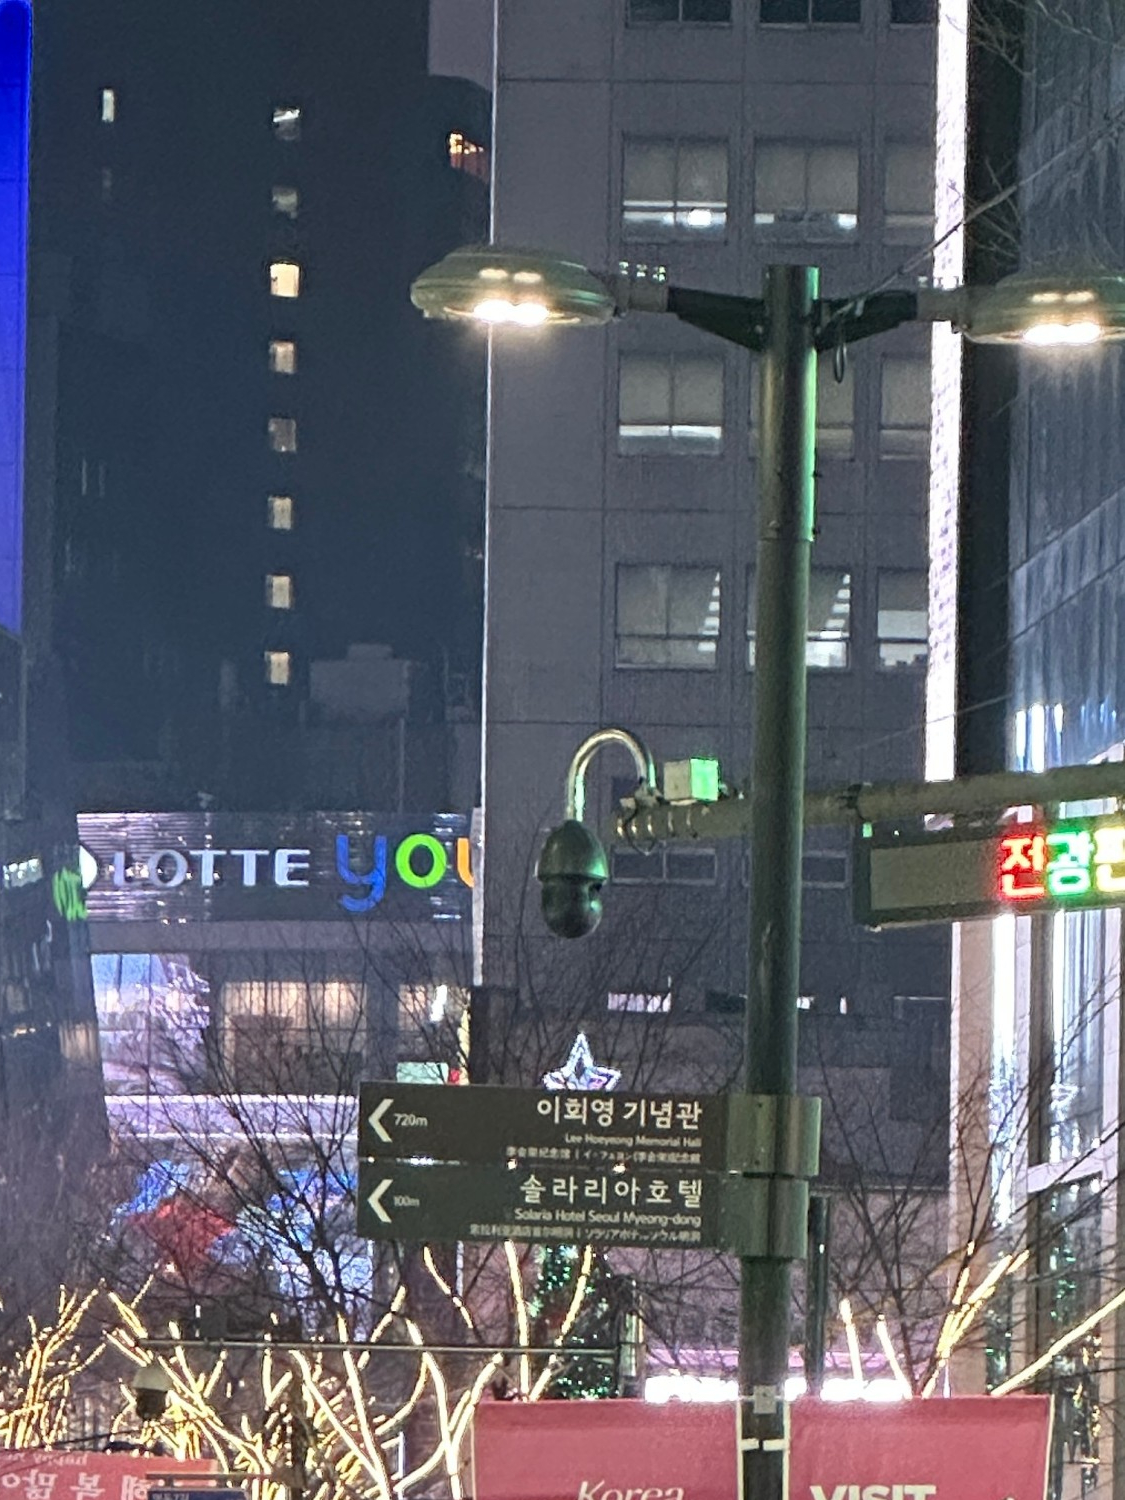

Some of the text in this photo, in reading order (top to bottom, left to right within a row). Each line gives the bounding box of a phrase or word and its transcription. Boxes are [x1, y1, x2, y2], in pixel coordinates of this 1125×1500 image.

[113, 848, 311, 887] LOTTE
[394, 1113, 428, 1126] 720m
[537, 1096, 703, 1130] 이회영 기념관
[565, 1133, 582, 1144] Lee
[636, 1135, 680, 1147] Memorial
[683, 1136, 703, 1148] Hall
[393, 1195, 420, 1207] 100m
[520, 1174, 703, 1208] 솔라리아호텔
[515, 1208, 702, 1228] Solaria Hotel Seoul Myeong-dong
